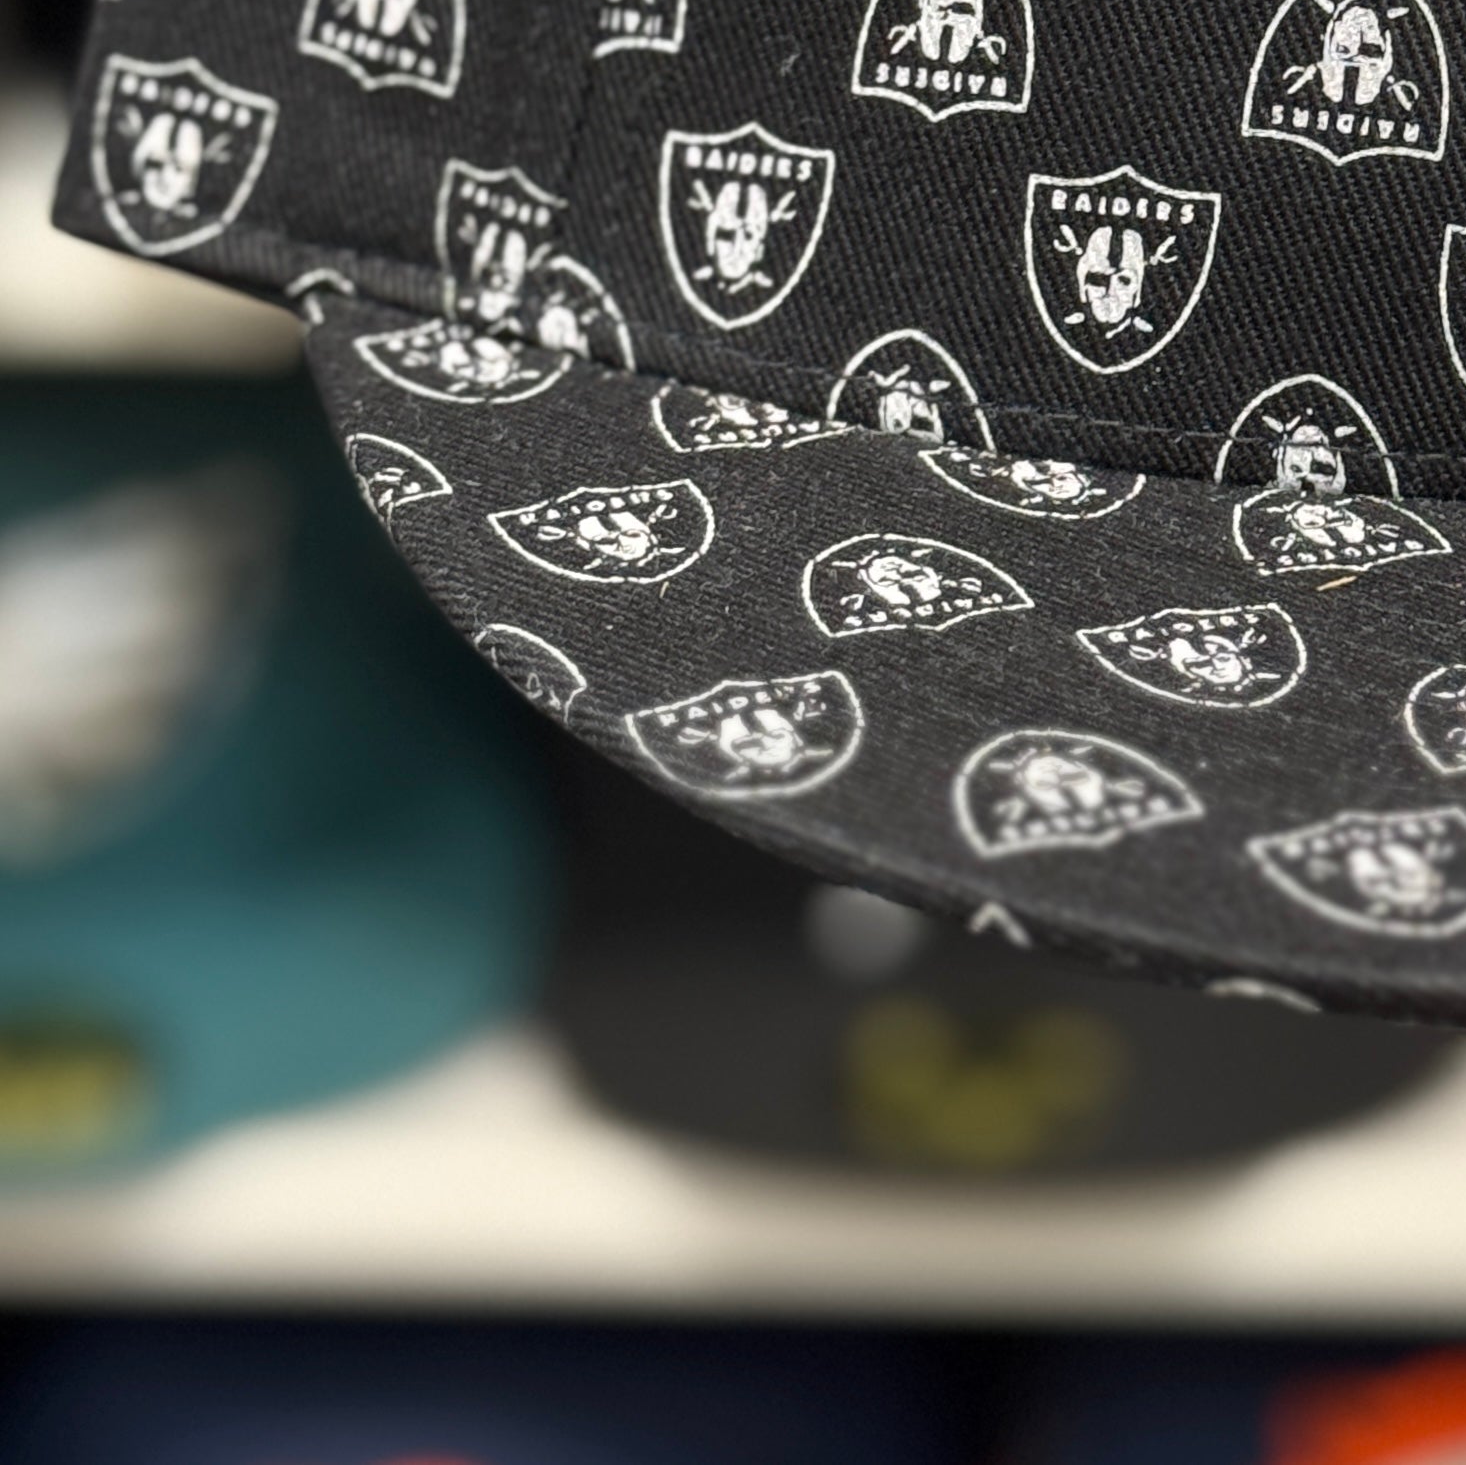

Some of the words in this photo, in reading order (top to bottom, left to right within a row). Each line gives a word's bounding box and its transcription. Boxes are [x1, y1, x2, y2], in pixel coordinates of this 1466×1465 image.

[875, 62, 1007, 97] RAIDERS
[1270, 105, 1420, 142] RAIDERS
[685, 146, 812, 180] RAIDERS
[1050, 189, 1196, 224] RAIDERS
